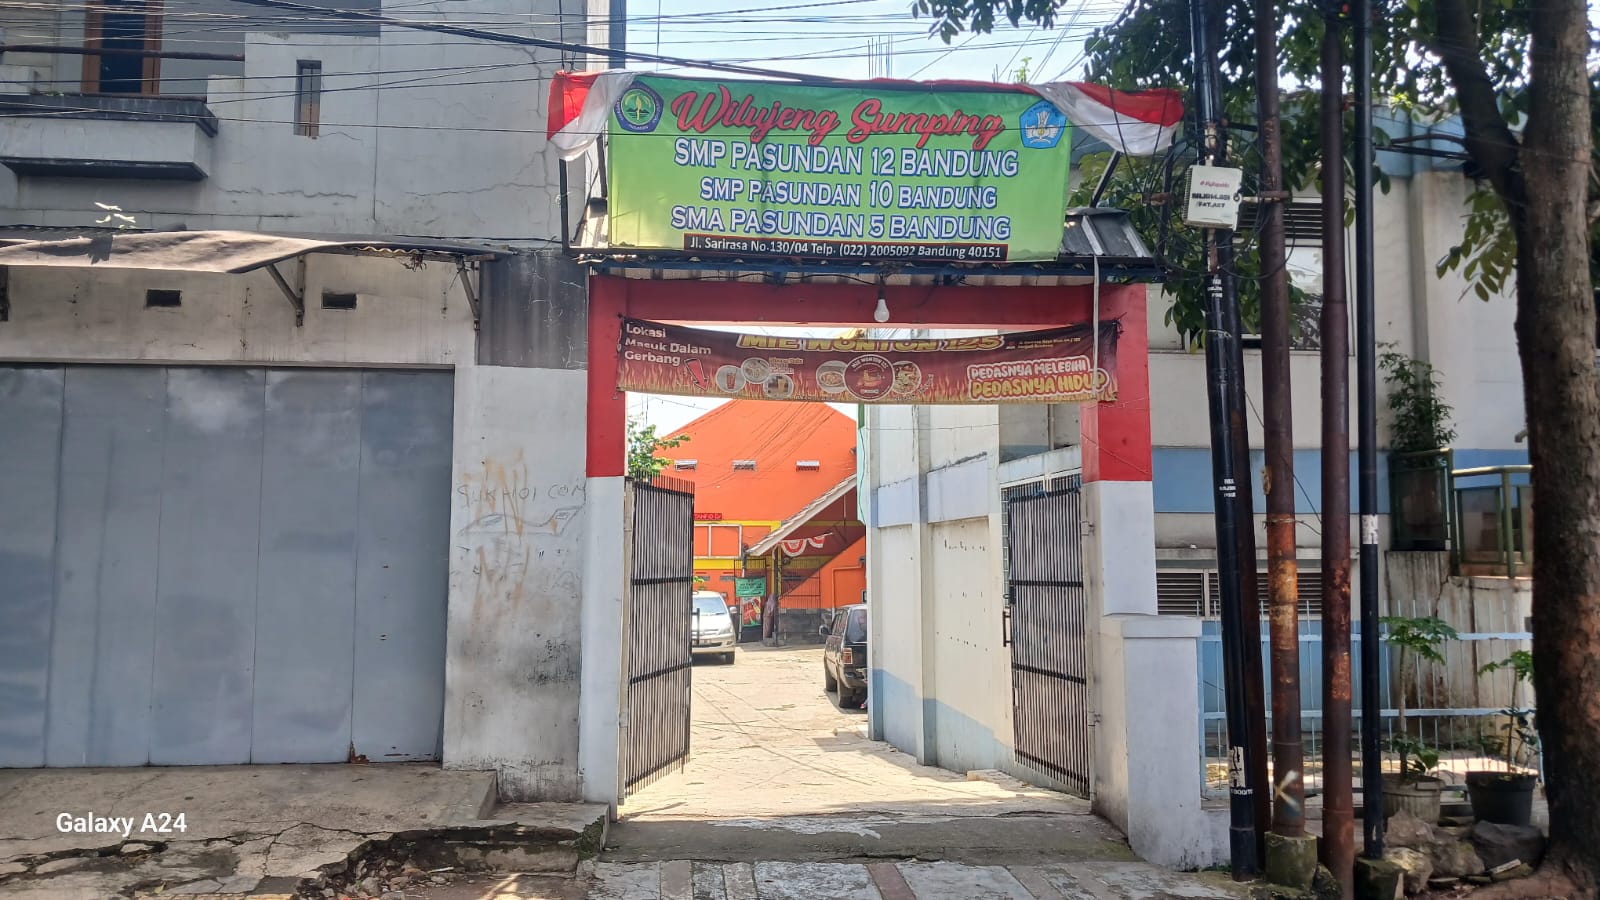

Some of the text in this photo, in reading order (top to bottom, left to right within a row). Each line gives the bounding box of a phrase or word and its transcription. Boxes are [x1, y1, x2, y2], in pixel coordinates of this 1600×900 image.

[672, 84, 840, 146] Wilujeng
[846, 98, 1006, 150] Sumping
[674, 137, 1019, 177] SMP PASUNDAN 12 BANDUNG
[700, 176, 998, 209] SMP PASUNDAN 10 BANDUNG
[671, 205, 1011, 240] SMA PASUNDAN 5 BANDUNG
[704, 237, 748, 251] Sarirasa
[839, 243, 868, 257] (022)
[870, 245, 916, 257] 2005092
[918, 245, 966, 260] Bandung
[968, 245, 1001, 258] 40151
[626, 322, 667, 339] Lokasi
[669, 342, 712, 356] Dalam
[740, 334, 801, 350] MIE
[804, 336, 938, 351] WONTON
[944, 335, 1003, 351] 125
[624, 350, 681, 367] Gerbang
[971, 358, 1088, 380] PEDASNYA MELEBIHI
[971, 371, 1106, 398] PEDASNYA HIDUP
